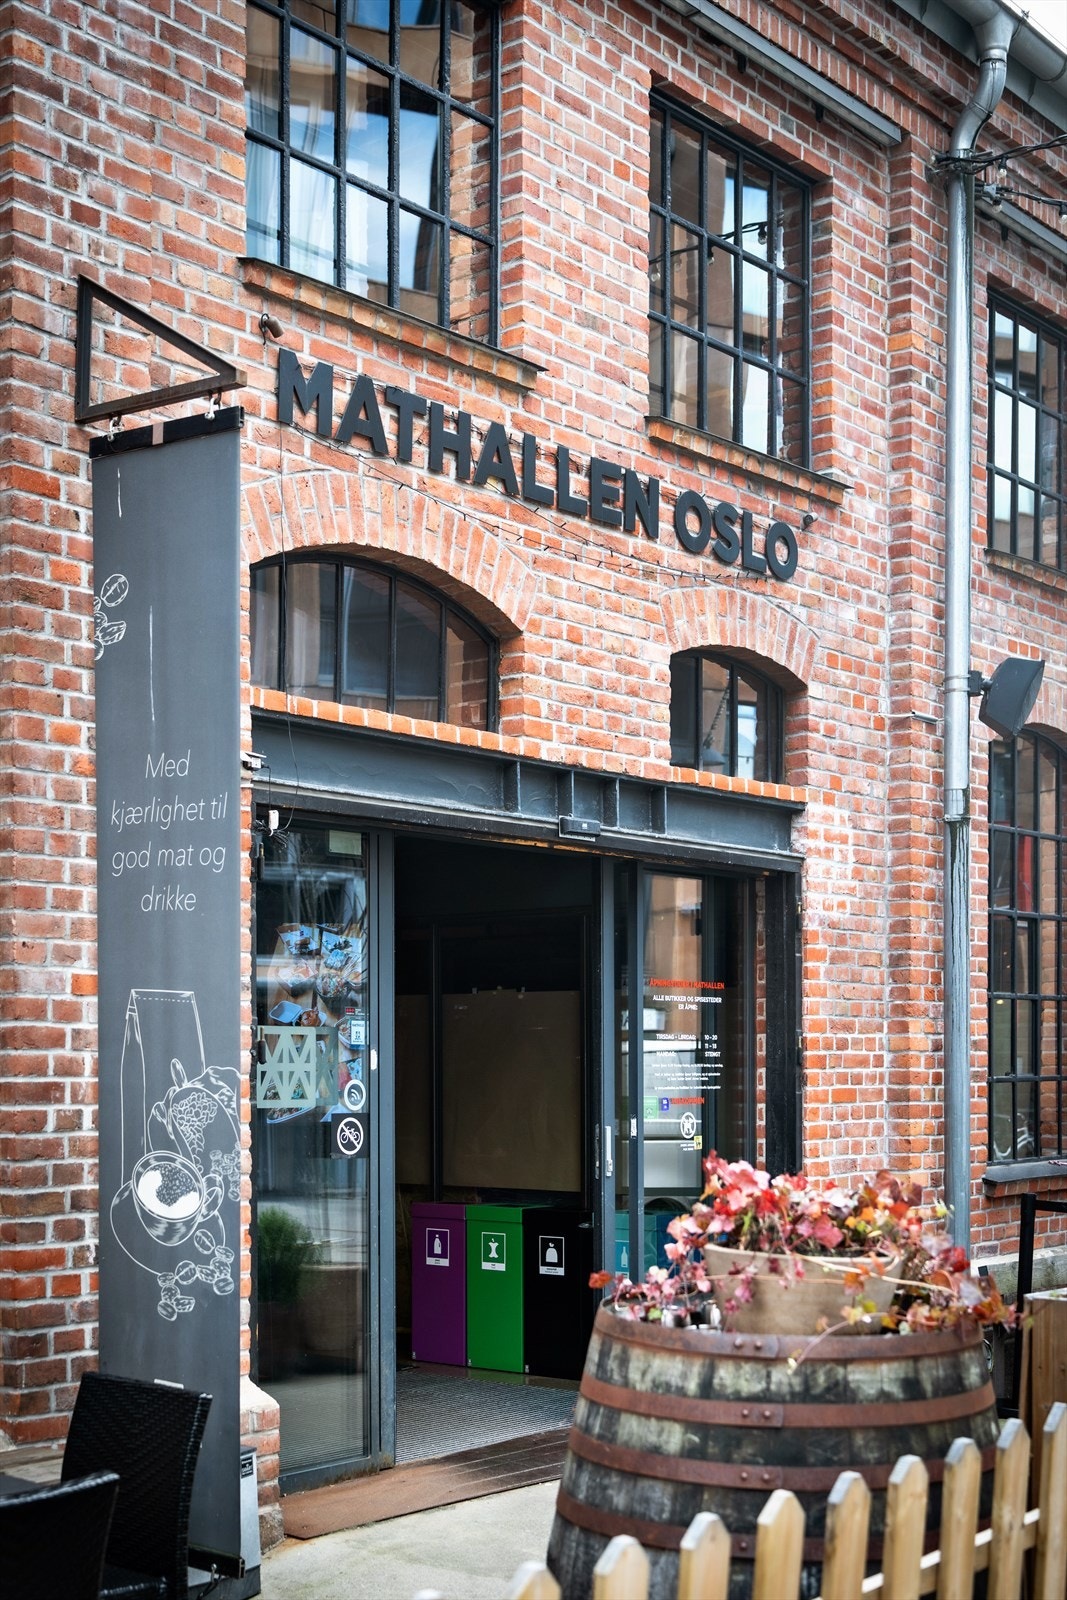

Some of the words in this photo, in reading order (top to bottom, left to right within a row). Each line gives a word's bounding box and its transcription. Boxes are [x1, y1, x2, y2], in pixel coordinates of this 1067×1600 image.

[277, 347, 660, 540] MATHALLEN
[674, 489, 800, 581] OSLO
[145, 749, 191, 779] Med
[110, 794, 206, 833] kjærlighet
[210, 791, 228, 820] til
[111, 841, 152, 877] god
[157, 844, 194, 867] mat
[199, 846, 226, 873] og
[140, 884, 197, 912] drikke
